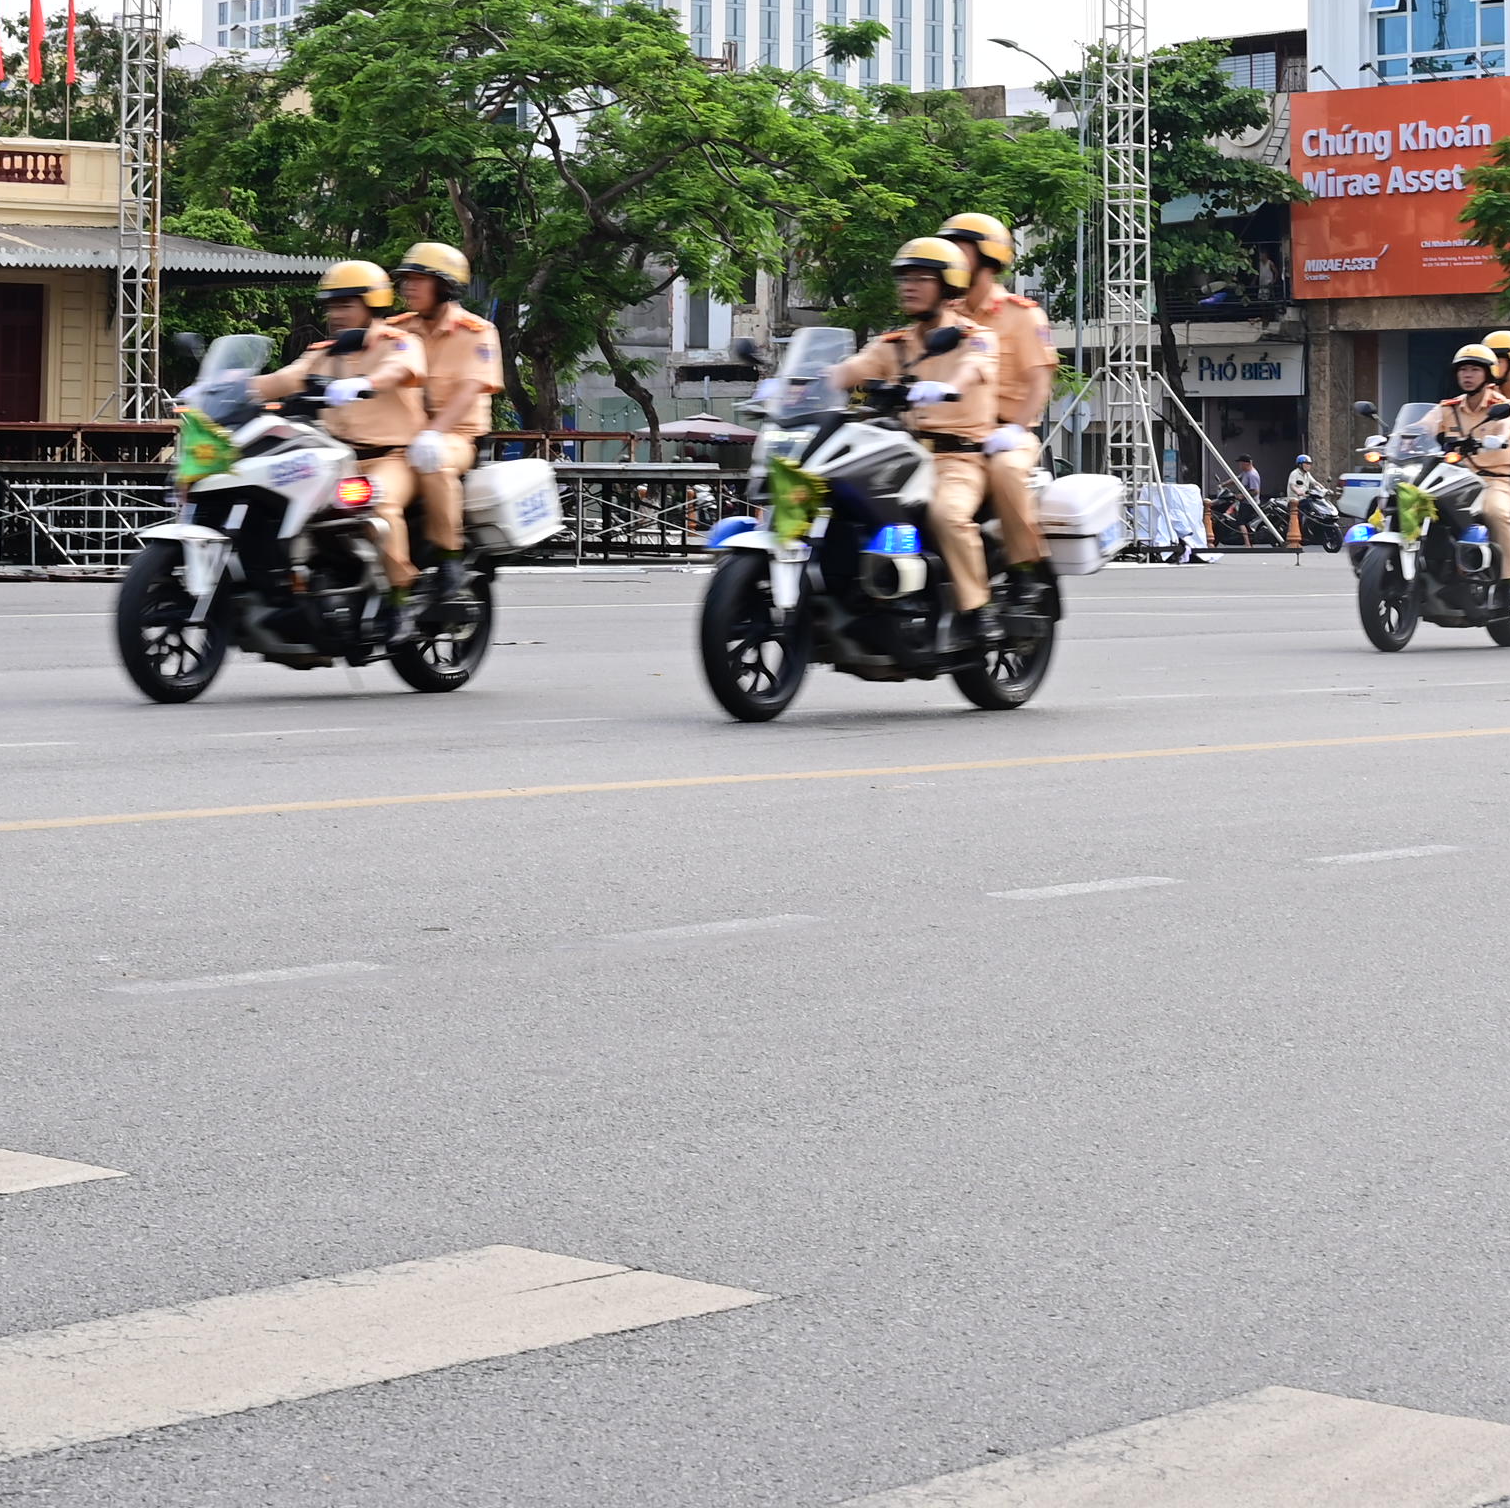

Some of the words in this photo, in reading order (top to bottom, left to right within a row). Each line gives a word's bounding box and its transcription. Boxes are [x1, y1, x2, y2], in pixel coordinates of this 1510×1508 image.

[1302, 124, 1392, 161] Chứng
[1399, 115, 1492, 151] Khoán
[1302, 168, 1380, 198] Mirae
[1386, 163, 1467, 194] Asset
[1304, 258, 1342, 272] MIRAE
[1342, 257, 1379, 271] ASSET
[1198, 353, 1237, 381] PHỐ
